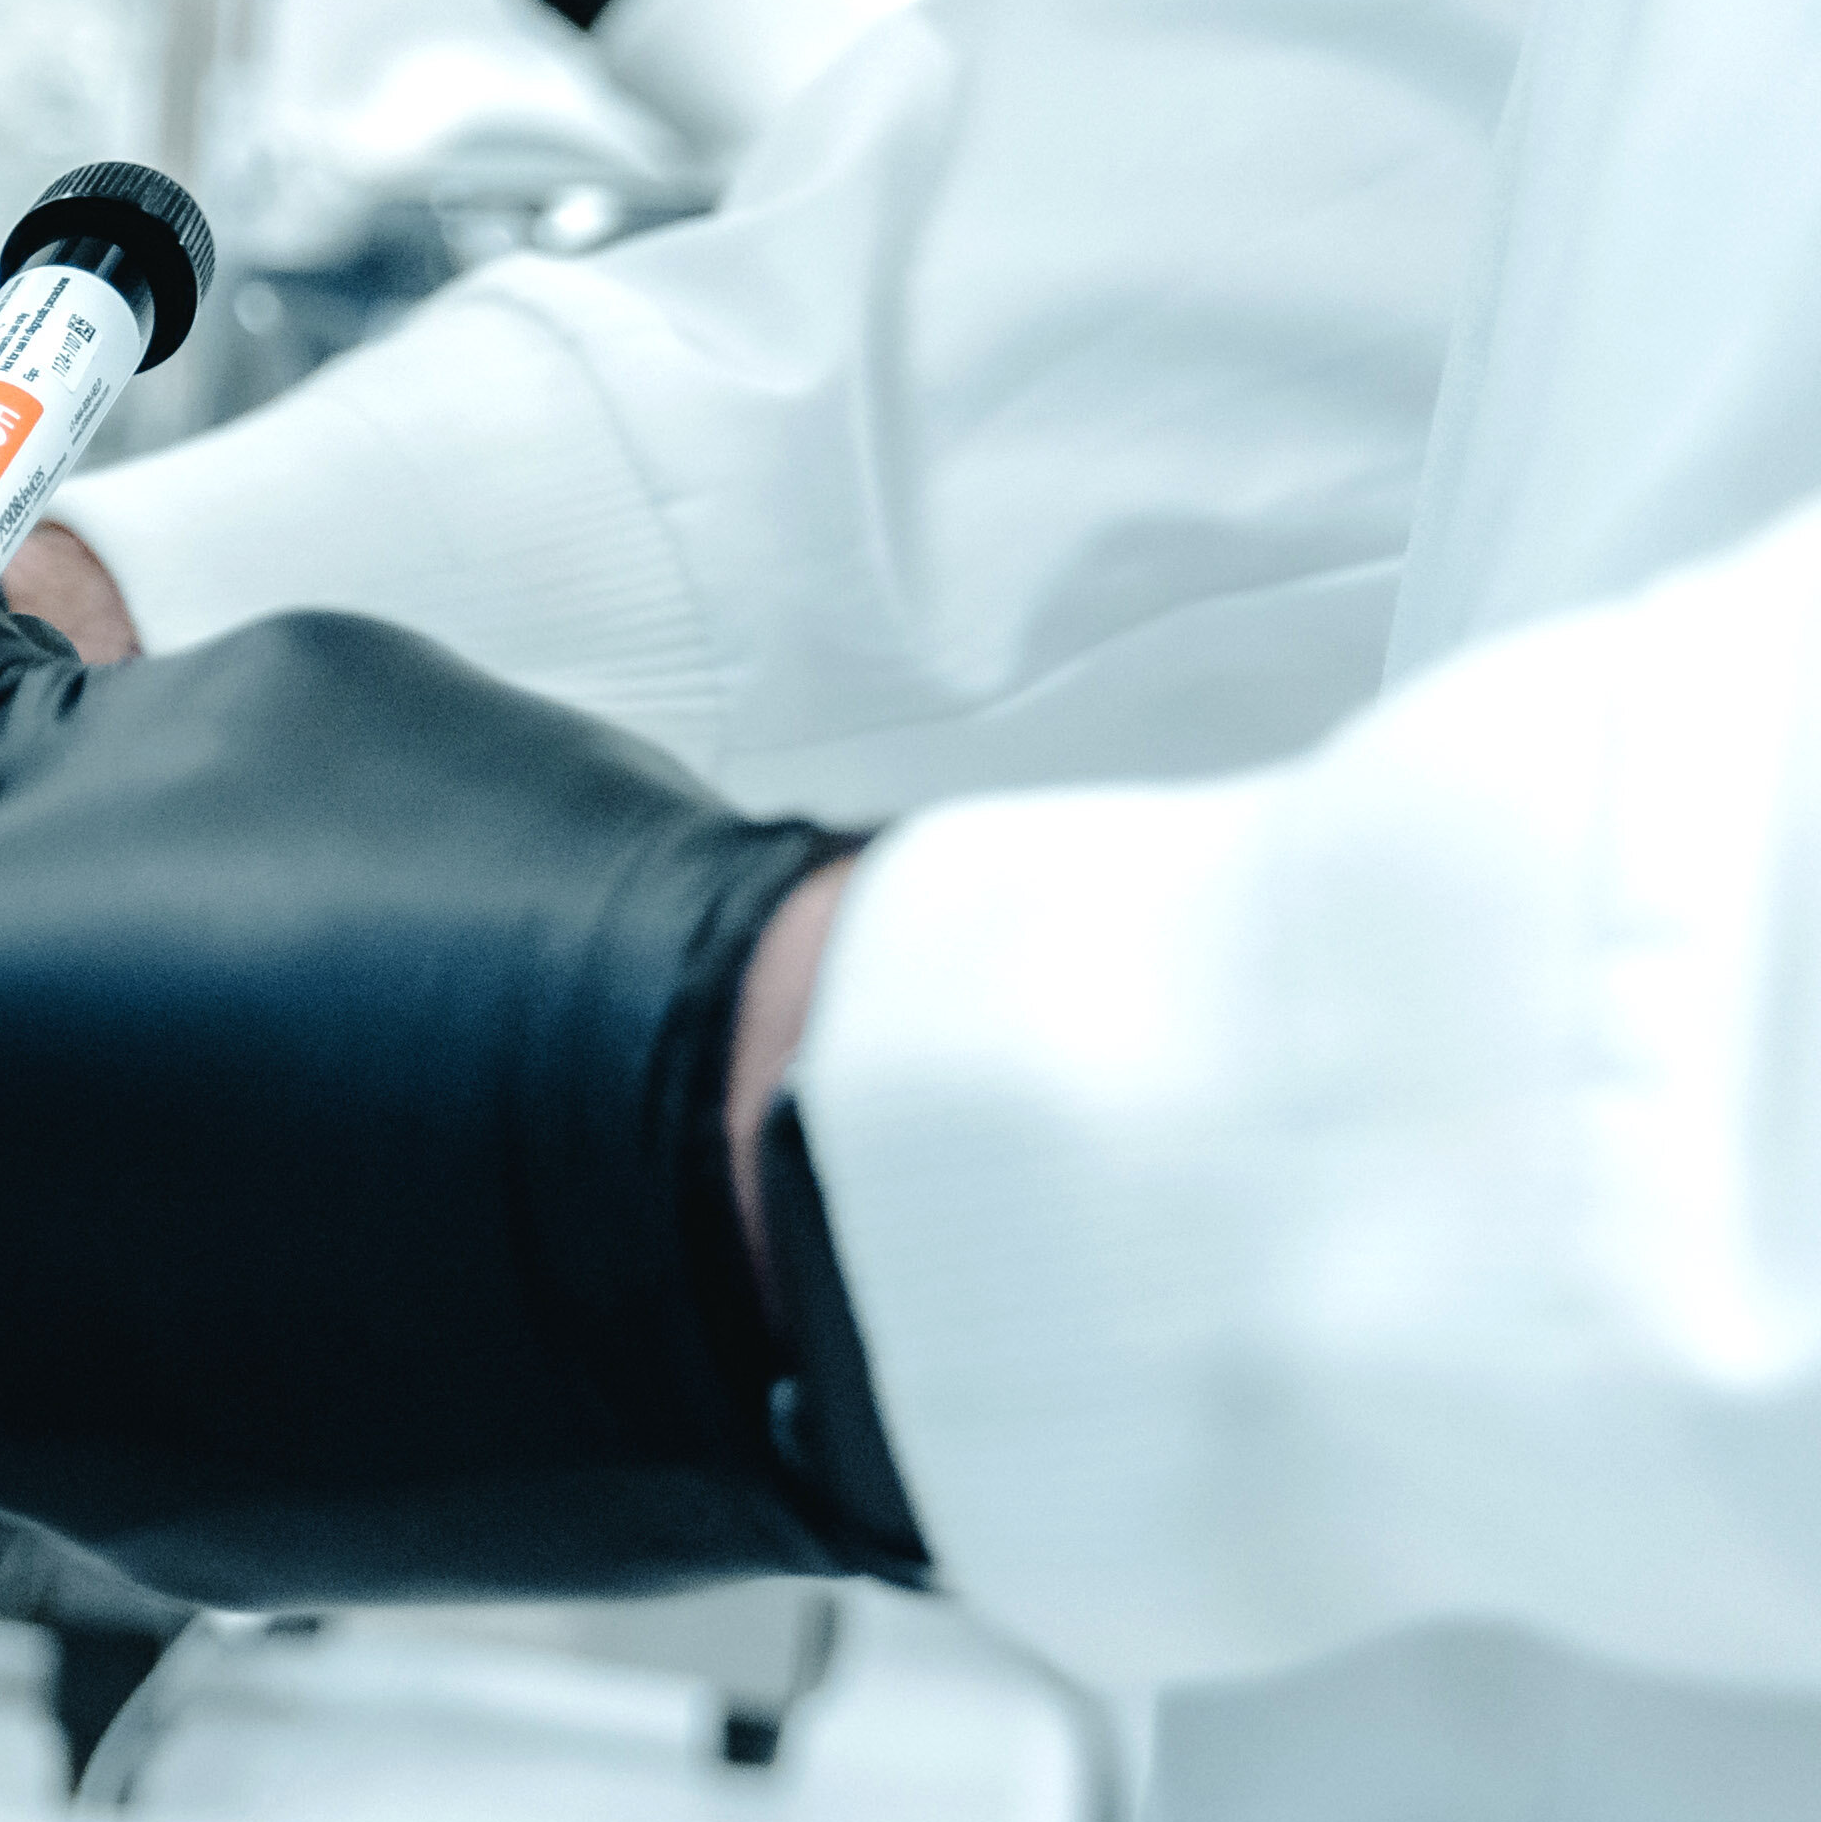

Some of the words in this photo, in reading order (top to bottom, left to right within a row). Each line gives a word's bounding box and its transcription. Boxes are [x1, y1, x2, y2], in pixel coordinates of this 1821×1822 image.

[0, 360, 15, 372] Not
[25, 307, 50, 336] diagnostic
[43, 277, 71, 309] procedures
[15, 312, 31, 325] only
[51, 331, 83, 377] 1124-1107
